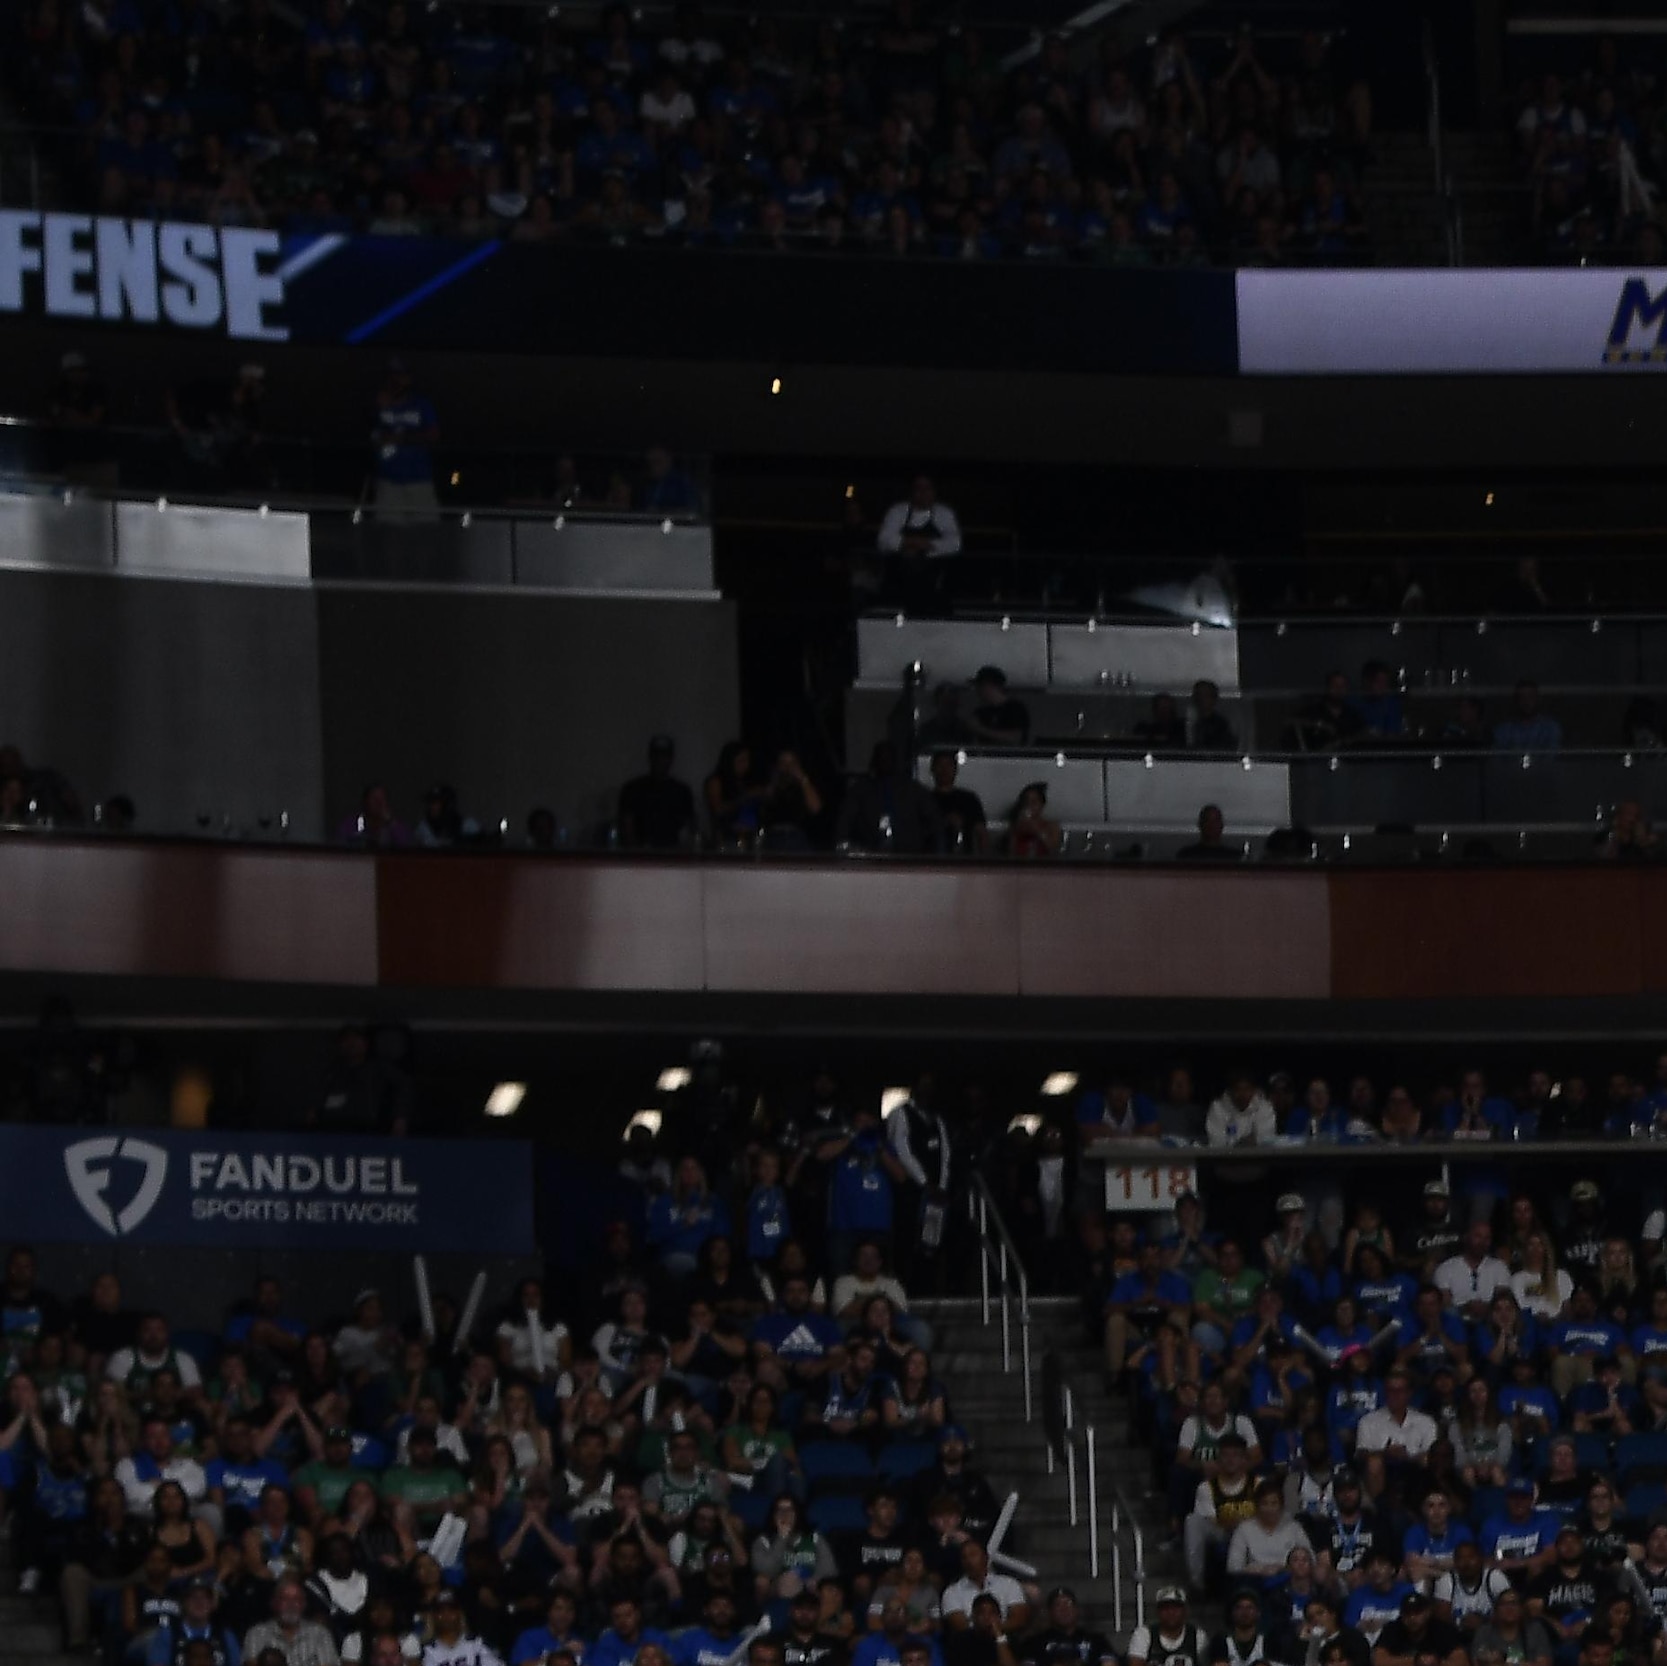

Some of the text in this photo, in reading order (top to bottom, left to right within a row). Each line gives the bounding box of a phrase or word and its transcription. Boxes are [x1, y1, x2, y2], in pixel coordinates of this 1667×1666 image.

[0, 207, 291, 342] FENSE
[190, 1152, 419, 1195] FANDUEL
[191, 1197, 419, 1225] SPORTS NETWORK
